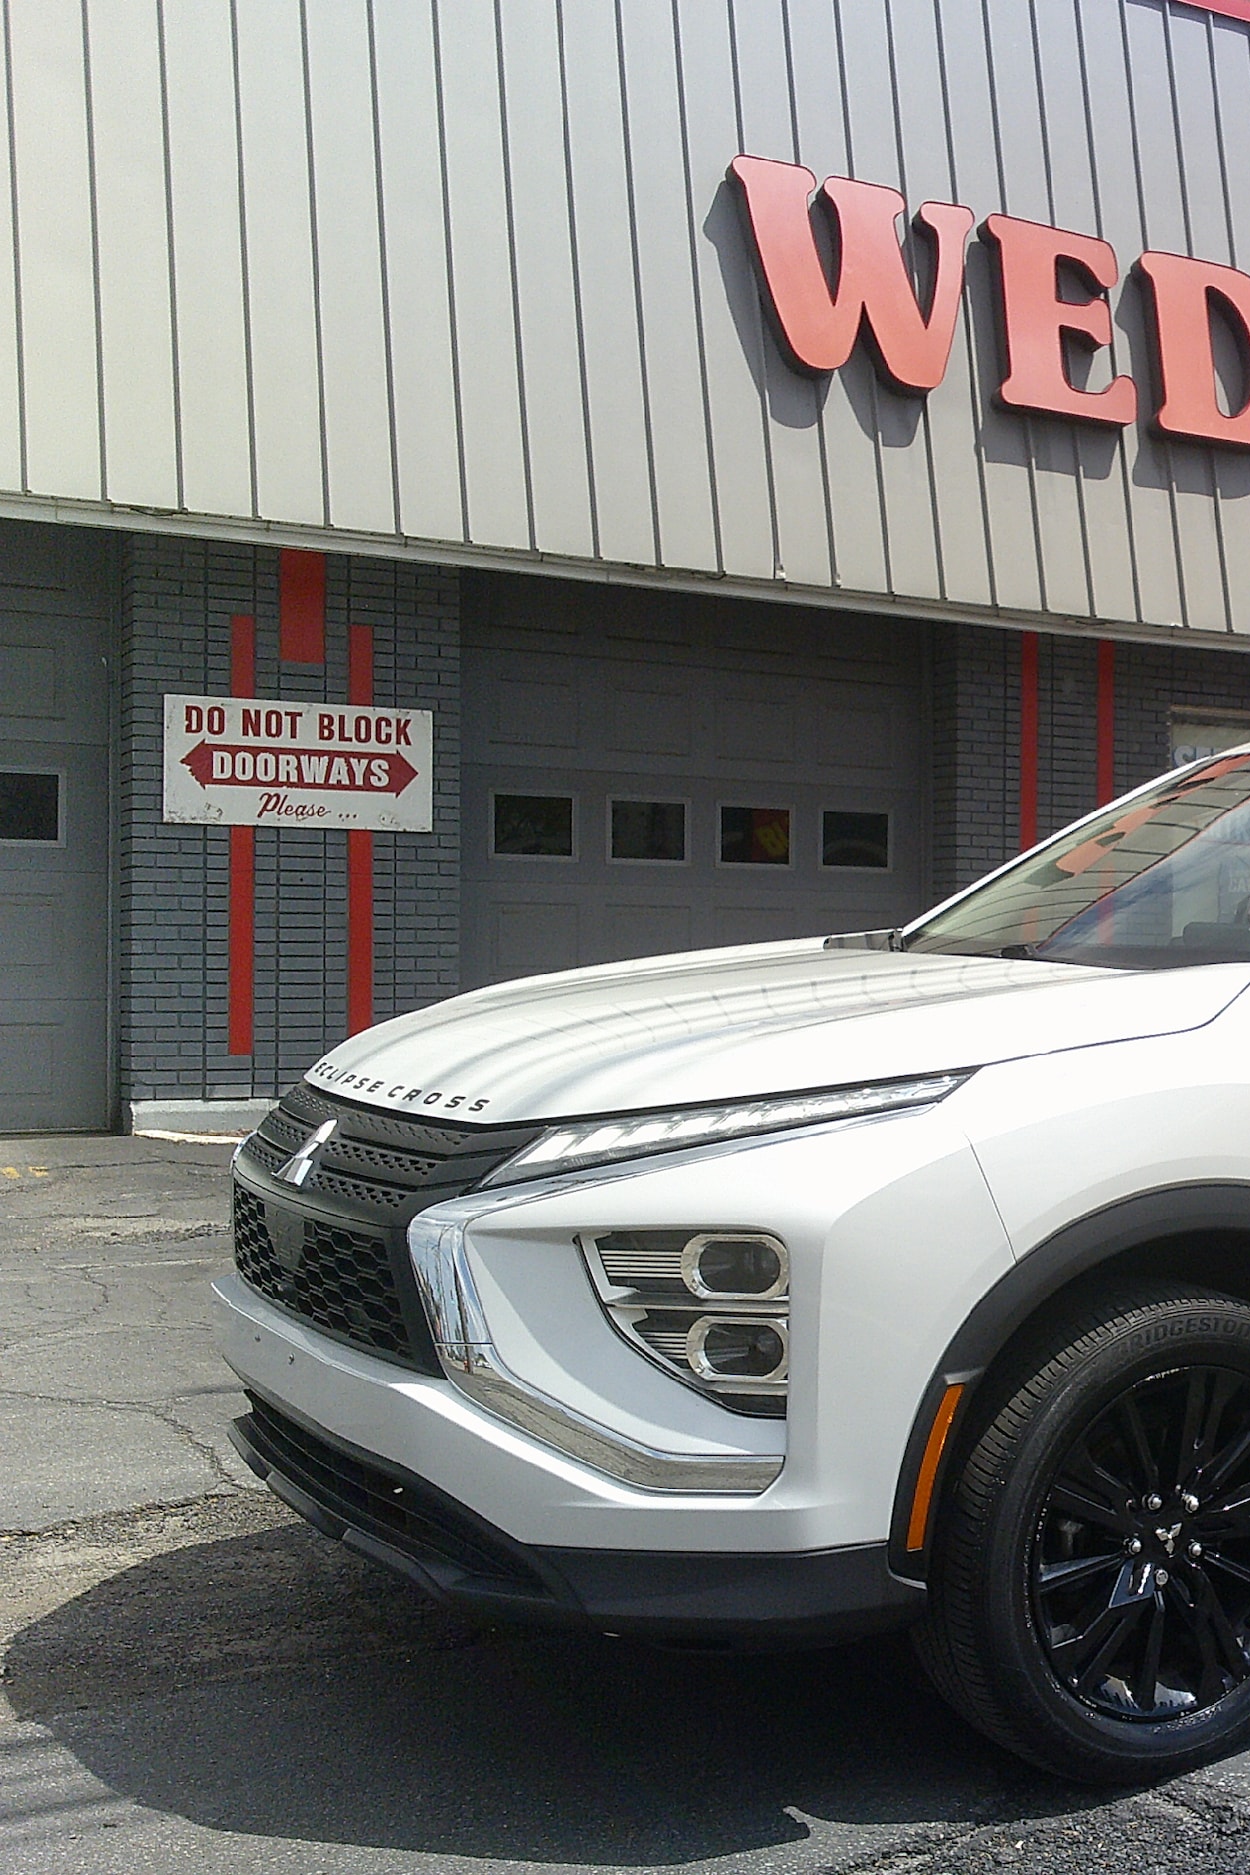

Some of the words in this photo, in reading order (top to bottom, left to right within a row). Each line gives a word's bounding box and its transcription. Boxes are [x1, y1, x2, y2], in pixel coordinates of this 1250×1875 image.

[185, 705, 226, 735] DO
[242, 708, 303, 739] NOT
[318, 713, 412, 746] BLOCK
[212, 750, 390, 788] DOORWAYS
[257, 792, 332, 819] Please
[314, 1062, 384, 1093] ECLIPSE
[387, 1085, 490, 1112] CROSS
